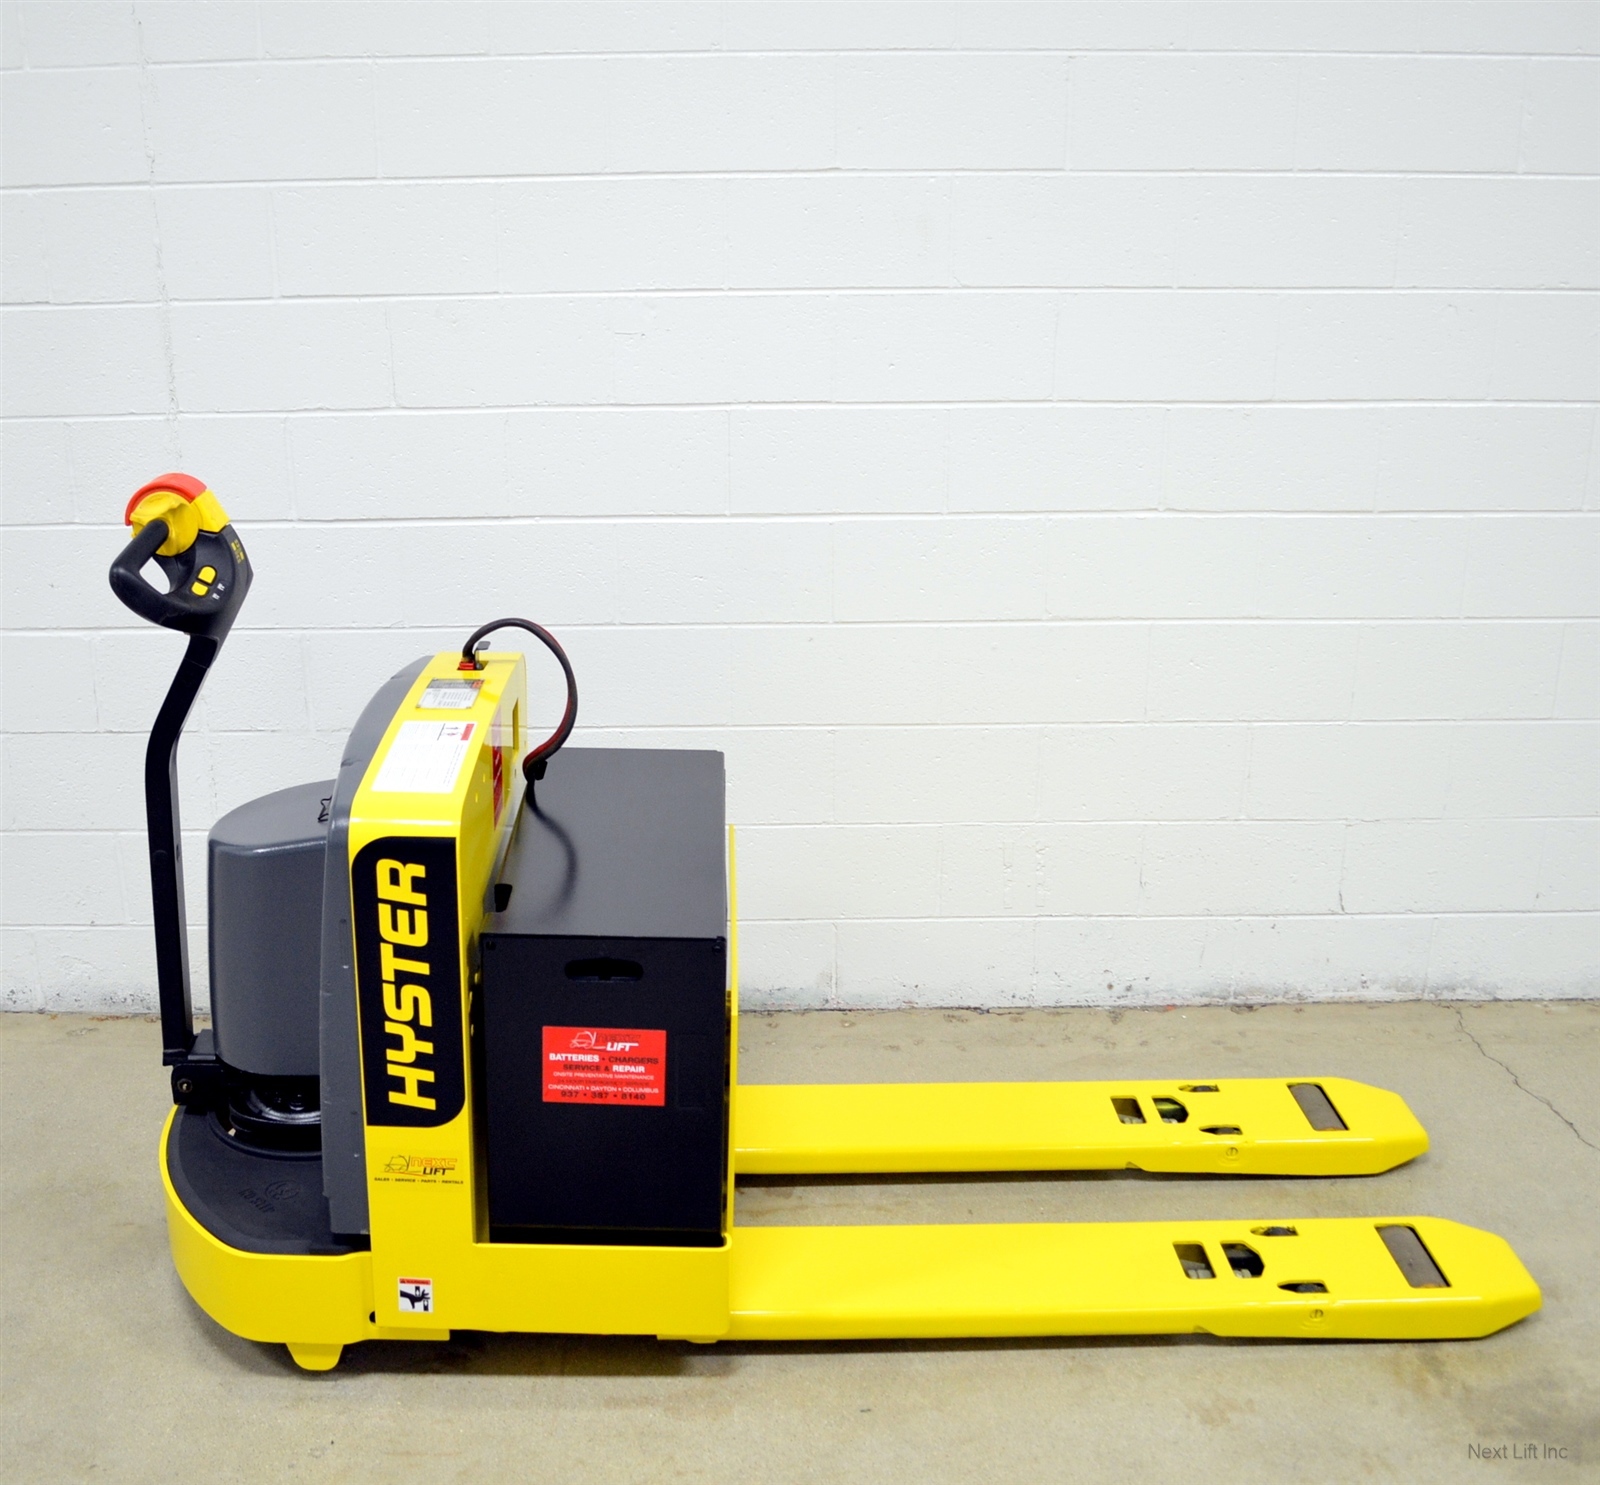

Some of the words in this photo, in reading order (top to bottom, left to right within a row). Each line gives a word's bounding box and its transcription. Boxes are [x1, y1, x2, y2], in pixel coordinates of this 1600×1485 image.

[376, 858, 436, 1111] HYSTER
[606, 1042, 639, 1052] LIFT
[549, 1053, 600, 1062] BATTERIES
[608, 1056, 659, 1065] CHARGERS
[612, 1065, 645, 1073] REPAIR
[561, 1090, 580, 1098] 937
[590, 1091, 609, 1099] 387
[621, 1092, 646, 1100] 8140
[423, 1167, 455, 1176] LIFT
